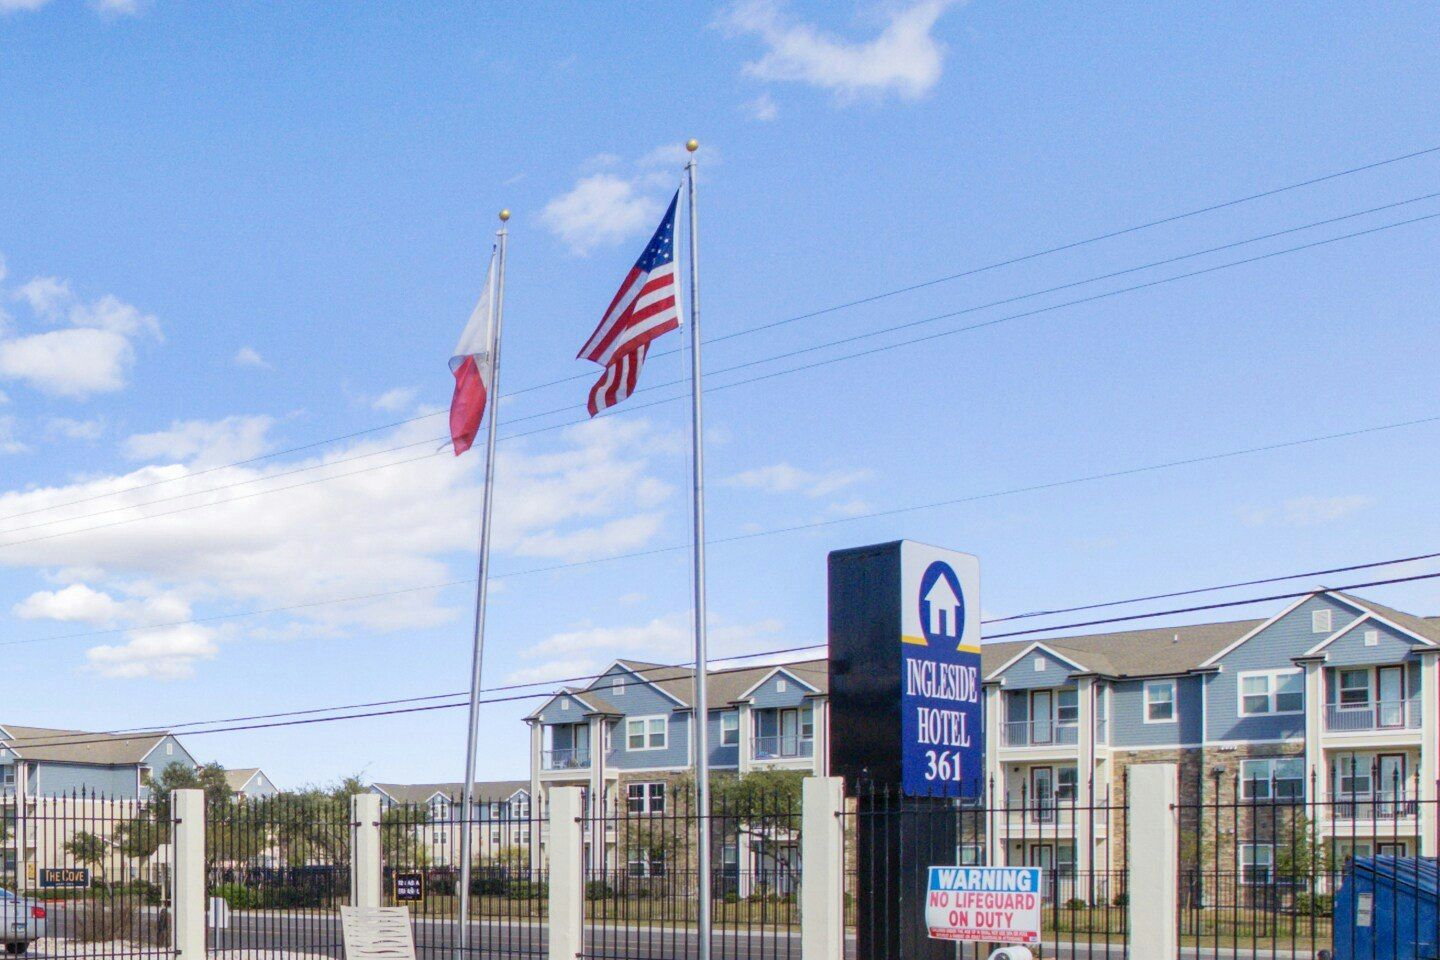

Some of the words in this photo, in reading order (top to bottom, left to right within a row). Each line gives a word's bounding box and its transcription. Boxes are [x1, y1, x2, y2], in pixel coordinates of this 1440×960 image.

[906, 658, 978, 703] INGLESIDE
[917, 707, 971, 748] HOTEL
[924, 750, 962, 781] 361
[938, 868, 1032, 892] WARNING
[930, 892, 949, 908] NO
[955, 892, 1035, 910] LIFEGUARD
[949, 910, 968, 927] ON
[975, 911, 1014, 928] DUTY
